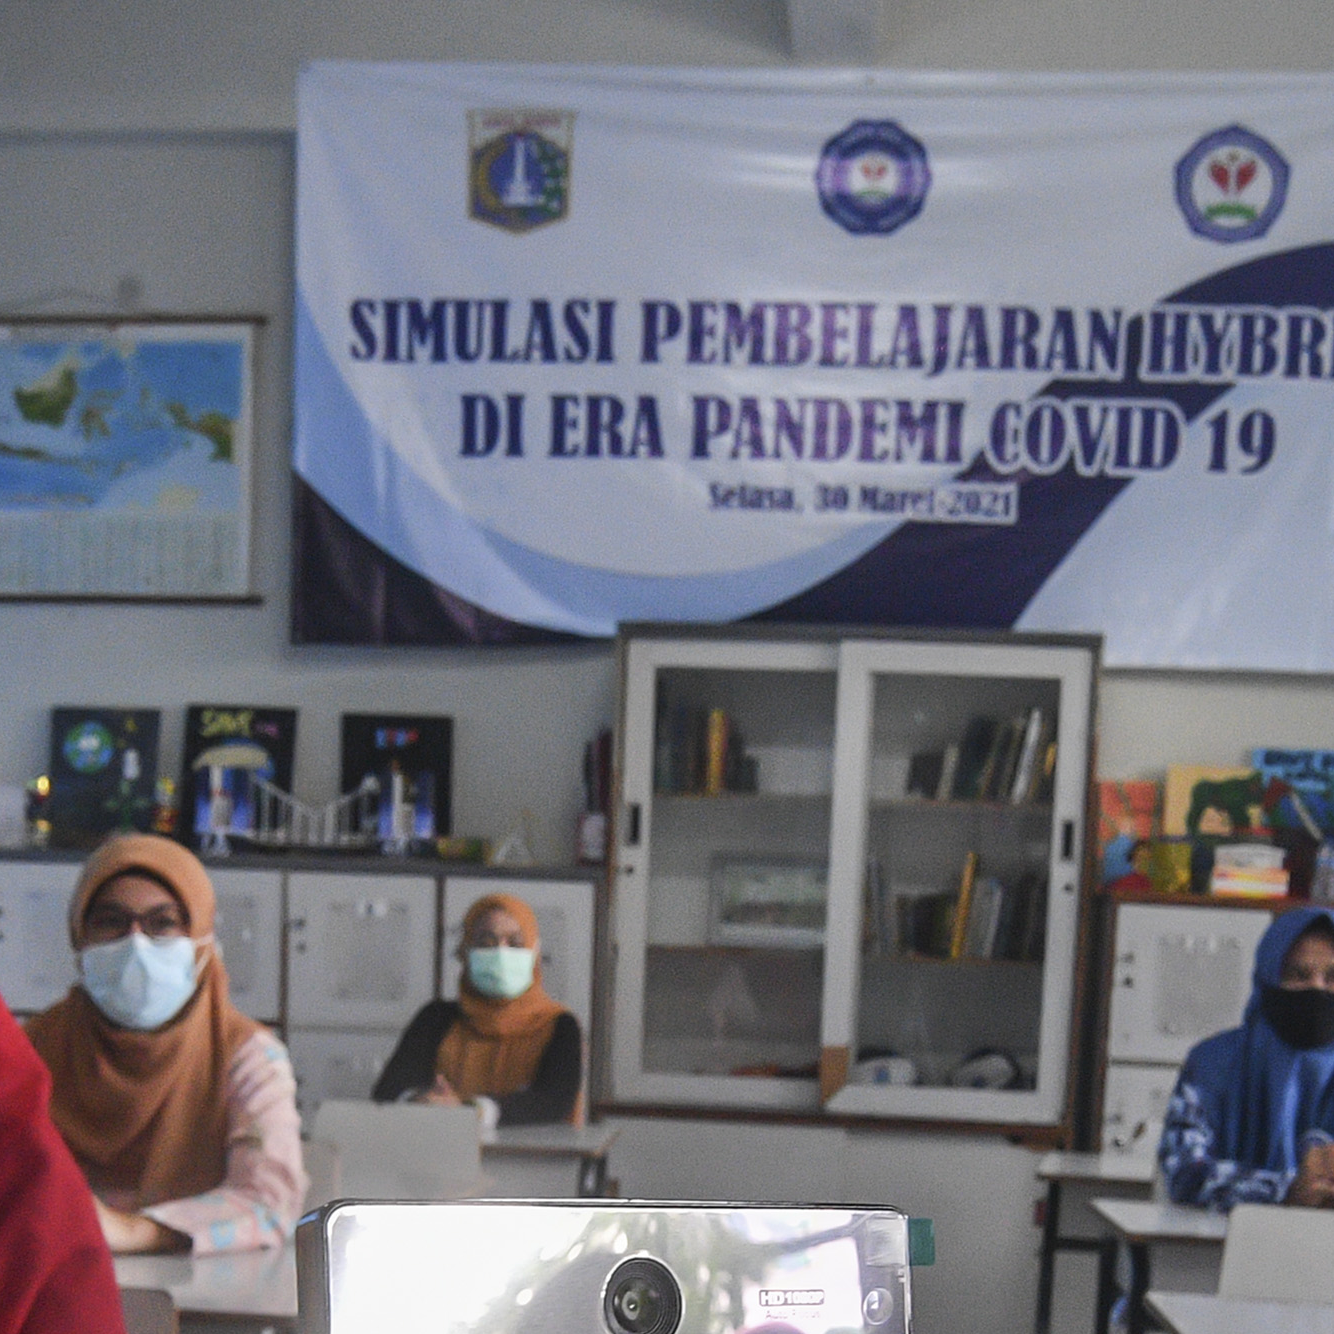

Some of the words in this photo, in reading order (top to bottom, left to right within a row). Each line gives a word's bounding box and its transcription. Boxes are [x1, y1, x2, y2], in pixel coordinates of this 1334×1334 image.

[349, 298, 616, 365] SIMULASI
[640, 300, 1122, 377] PEMBELAJARAN
[460, 393, 524, 457] DI
[549, 393, 665, 458] ERA
[690, 395, 964, 464] PANDEMI
[990, 402, 1182, 470] COVID
[1206, 409, 1276, 474] 19
[817, 484, 850, 511] 30
[947, 490, 1011, 517] 2021
